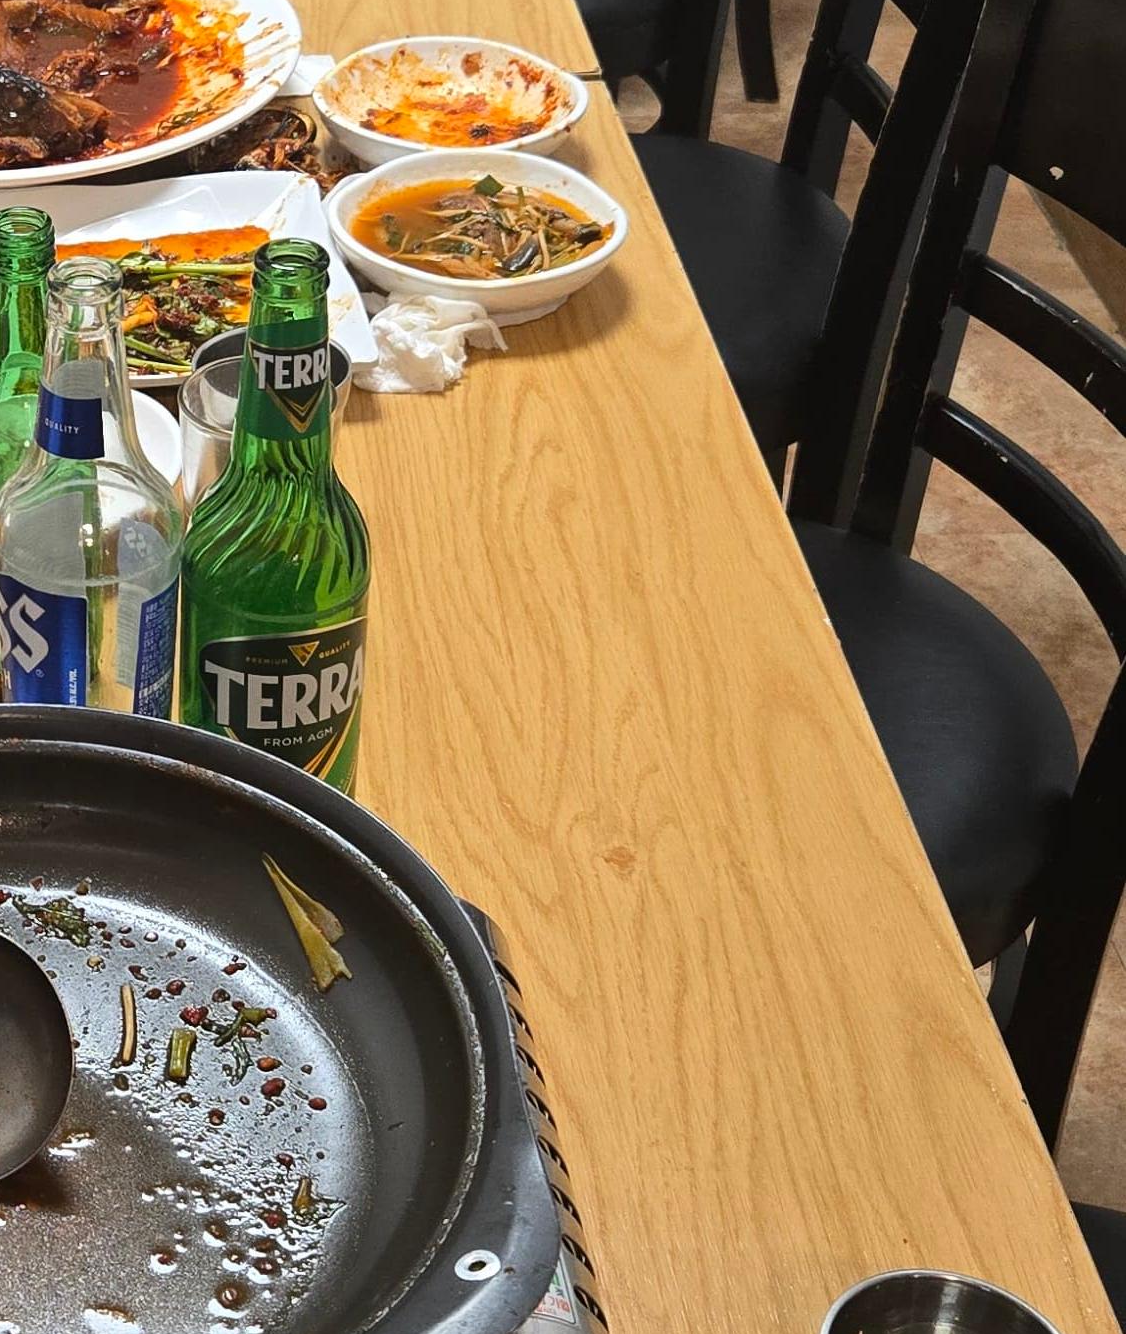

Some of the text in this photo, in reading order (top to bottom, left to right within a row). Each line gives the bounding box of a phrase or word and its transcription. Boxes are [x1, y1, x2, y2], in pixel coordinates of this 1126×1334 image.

[252, 348, 327, 390] TERR
[44, 418, 81, 435] QUALITY
[318, 640, 351, 659] QUALITY
[204, 645, 363, 730] TERRA
[263, 736, 303, 748] FROM
